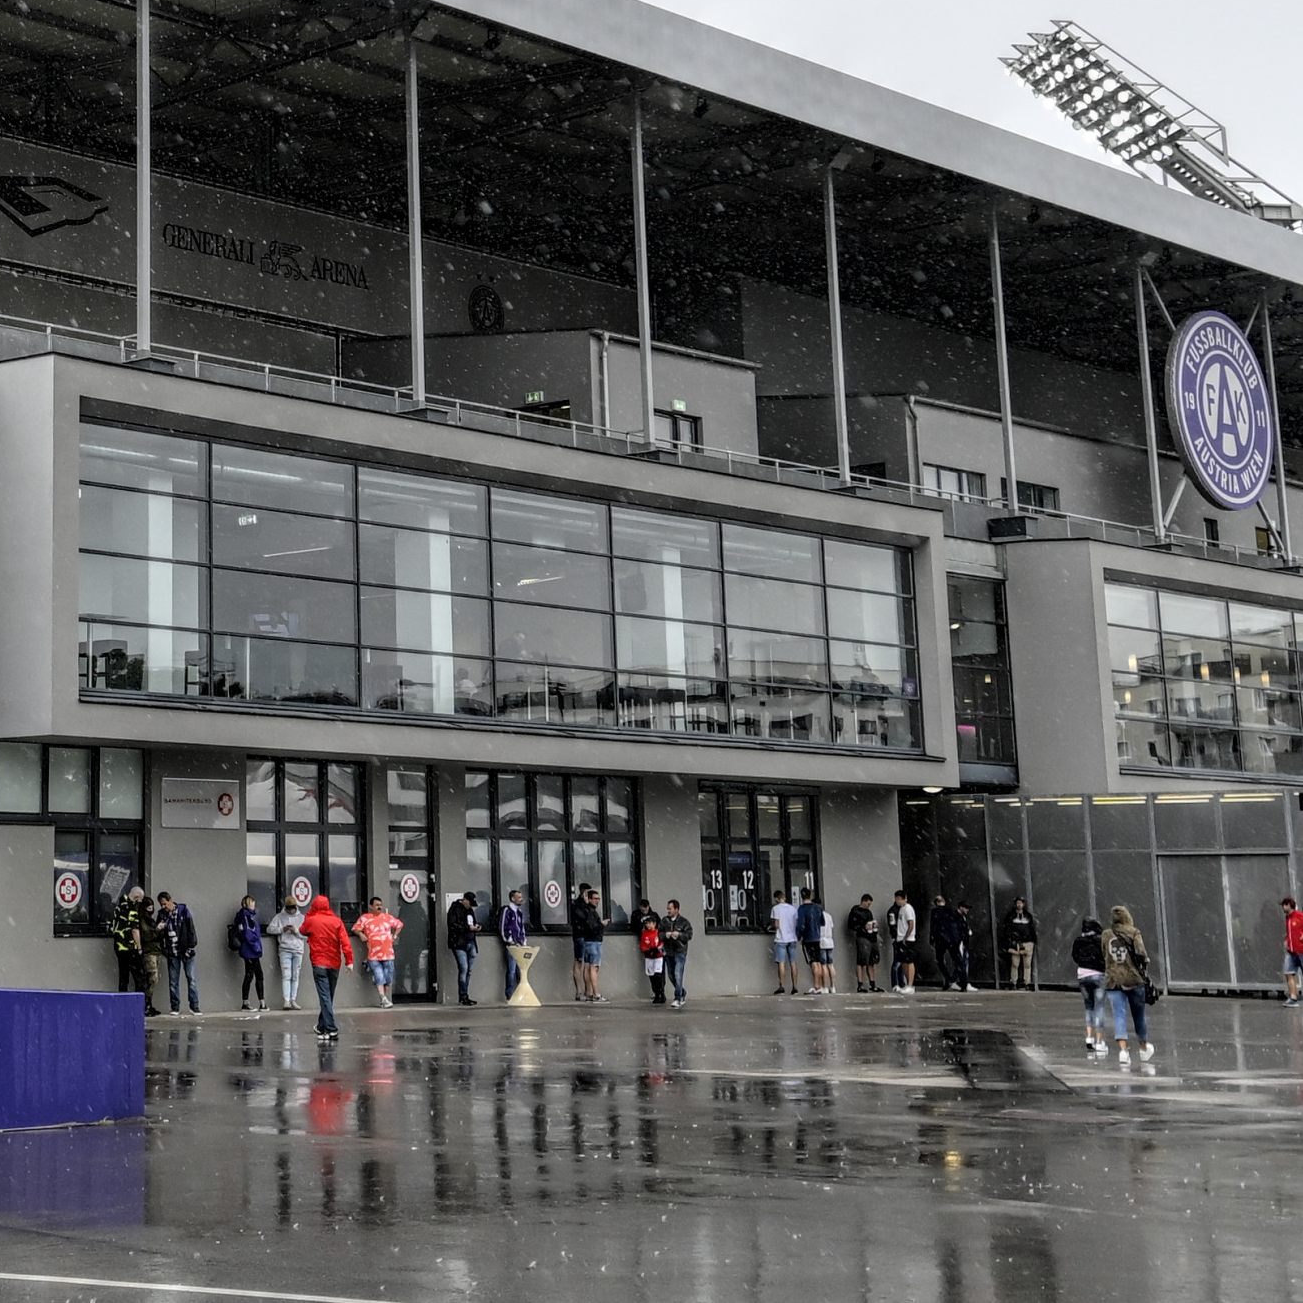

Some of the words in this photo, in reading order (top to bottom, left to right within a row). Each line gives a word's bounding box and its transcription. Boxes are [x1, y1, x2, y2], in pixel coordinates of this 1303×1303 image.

[163, 223, 255, 265] GENERALI
[310, 256, 369, 289] ARENA
[1185, 326, 1258, 390] FUSSBALLKLUB
[1184, 391, 1196, 410] 19
[1256, 409, 1266, 428] 11
[1194, 437, 1241, 494] AUSTRIA
[1240, 453, 1264, 491] WIEN
[65, 885, 72, 895] S
[710, 869, 723, 890] 13
[743, 869, 754, 890] 12
[804, 870, 814, 890] 11
